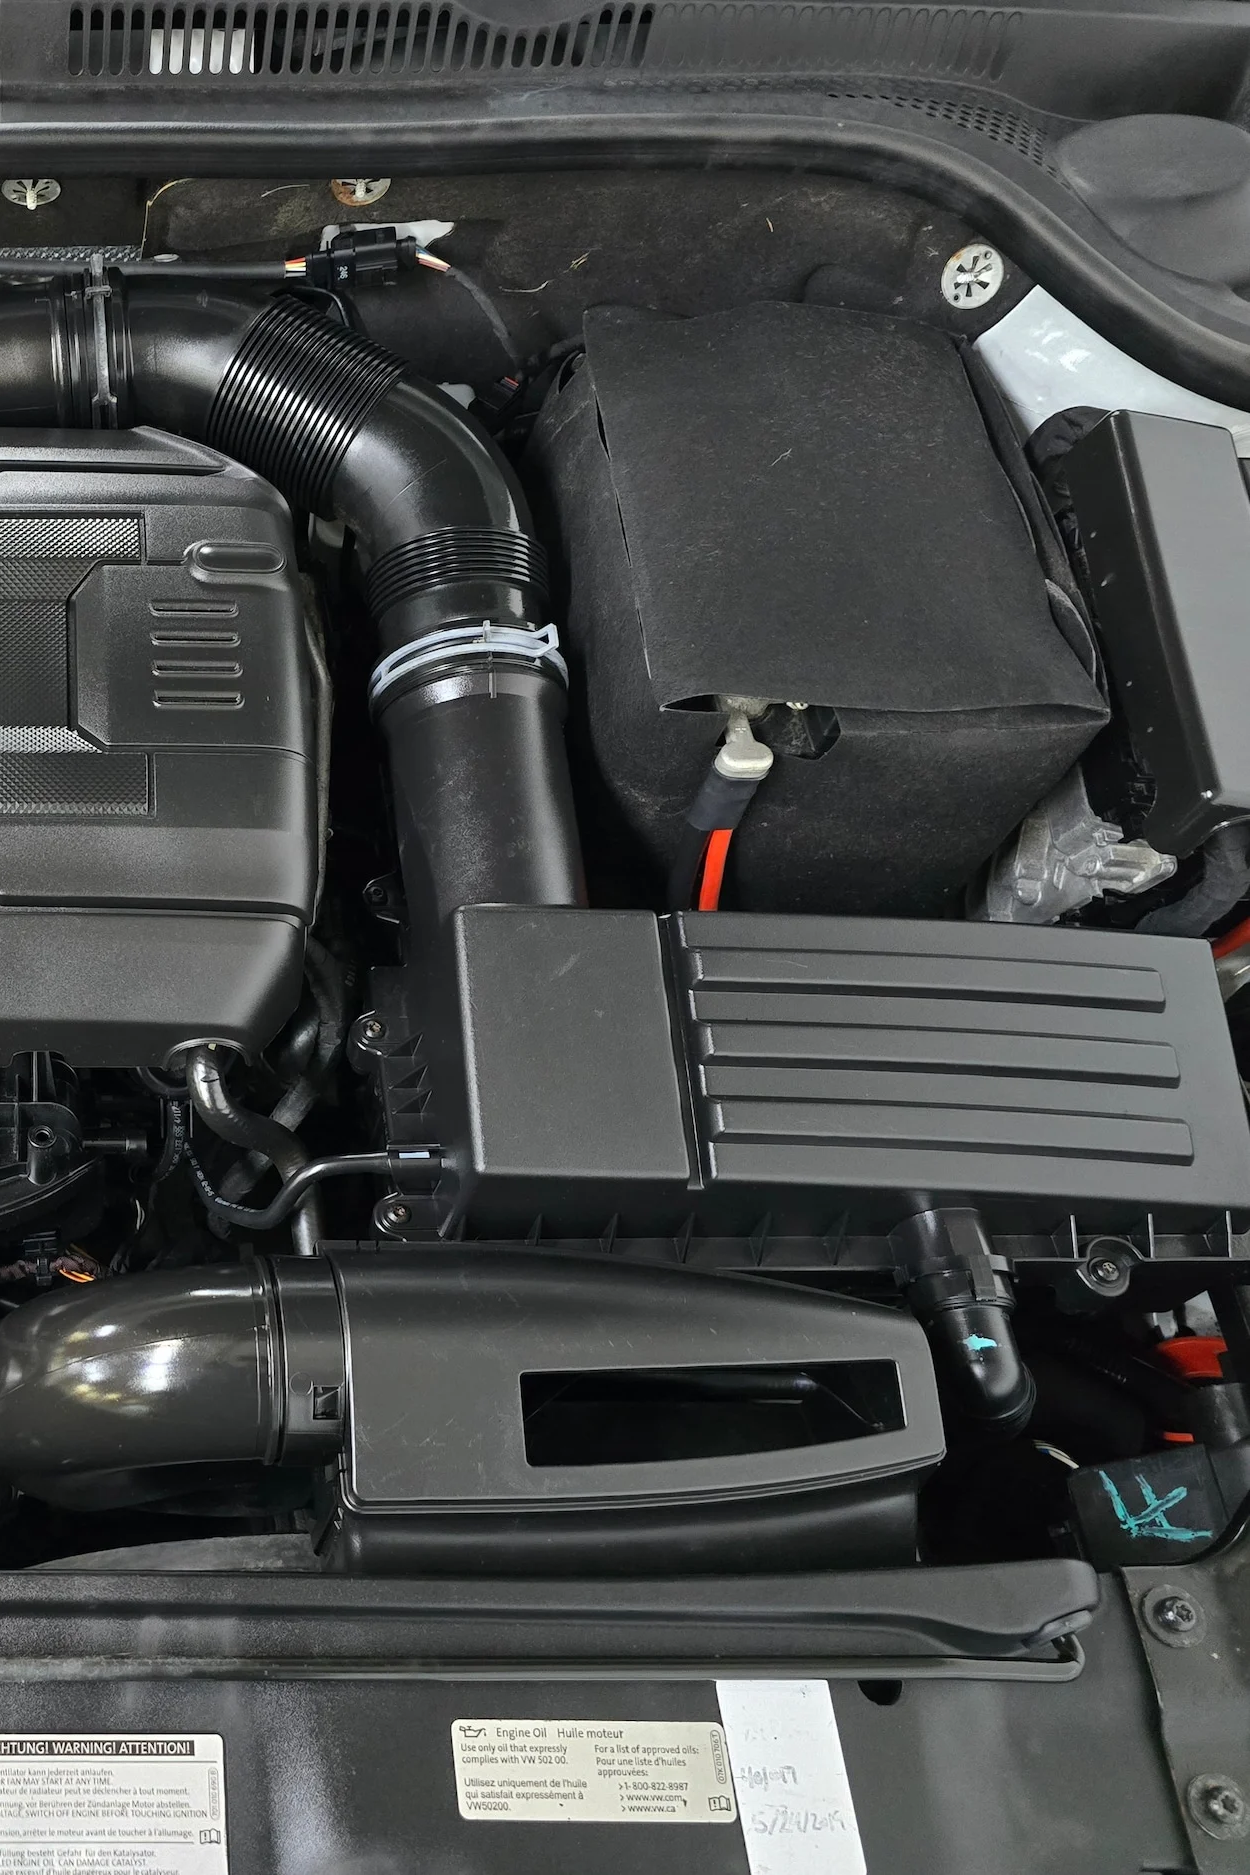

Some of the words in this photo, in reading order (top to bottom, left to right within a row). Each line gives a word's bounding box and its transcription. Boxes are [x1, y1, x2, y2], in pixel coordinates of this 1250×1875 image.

[496, 1727, 531, 1740] Engine
[533, 1727, 547, 1738] Oil
[557, 1728, 584, 1738] Huile
[587, 1729, 624, 1739] moteur
[52, 1742, 116, 1754] WARNING!
[119, 1742, 190, 1754] ATTENTION!
[460, 1743, 476, 1752] Use
[478, 1743, 495, 1754] only
[498, 1743, 508, 1752] oil
[510, 1743, 527, 1752] that
[529, 1743, 567, 1755] expressly
[594, 1744, 608, 1753] For
[616, 1744, 630, 1753] list
[631, 1744, 640, 1753] of
[641, 1744, 680, 1756] approved
[682, 1745, 699, 1754] oils:
[462, 1755, 499, 1765] complies
[500, 1755, 519, 1764] with
[521, 1756, 536, 1764] VW
[538, 1756, 553, 1764] 502
[554, 1756, 568, 1765] 00.
[596, 1757, 615, 1766] Pour
[617, 1758, 633, 1766] une
[635, 1757, 652, 1766] liste
[654, 1757, 687, 1766] d'huiles
[28, 1767, 46, 1776] kann
[47, 1768, 79, 1778] jederzeit
[597, 1768, 649, 1778] approuvées:
[7, 1777, 21, 1786] FAN
[23, 1777, 39, 1786] MAY
[41, 1777, 62, 1786] START
[65, 1777, 73, 1786] AT
[75, 1777, 90, 1786] ANY
[464, 1777, 495, 1787] Utilisez
[497, 1778, 548, 1790] uniquement
[549, 1779, 561, 1787] de
[562, 1779, 587, 1788] l'huile
[19, 1787, 28, 1795] de
[30, 1787, 63, 1796] radiateur
[64, 1788, 81, 1798] peut
[139, 1787, 154, 1796] tout
[465, 1790, 478, 1800] qui
[480, 1790, 514, 1799] satisfait
[578, 1790, 584, 1800] à
[39, 1800, 72, 1808] Berühren
[73, 1800, 86, 1808] der
[87, 1800, 130, 1810] Zündanlage
[132, 1800, 154, 1808] Motor
[466, 1801, 511, 1811] VW50200.
[627, 1805, 676, 1813] www.vw.ca
[131, 1810, 171, 1818] TOUCHING
[173, 1810, 207, 1818] IGNITION
[23, 1828, 47, 1837] arrêter
[48, 1828, 55, 1837] le
[56, 1829, 84, 1837] moteur
[85, 1829, 105, 1837] avant
[107, 1829, 117, 1837] de
[118, 1829, 146, 1837] toucher
[148, 1829, 153, 1837] à
[27, 1849, 55, 1857] besteht
[57, 1849, 82, 1857] Gefahr
[85, 1849, 95, 1857] für
[97, 1849, 111, 1857] den
